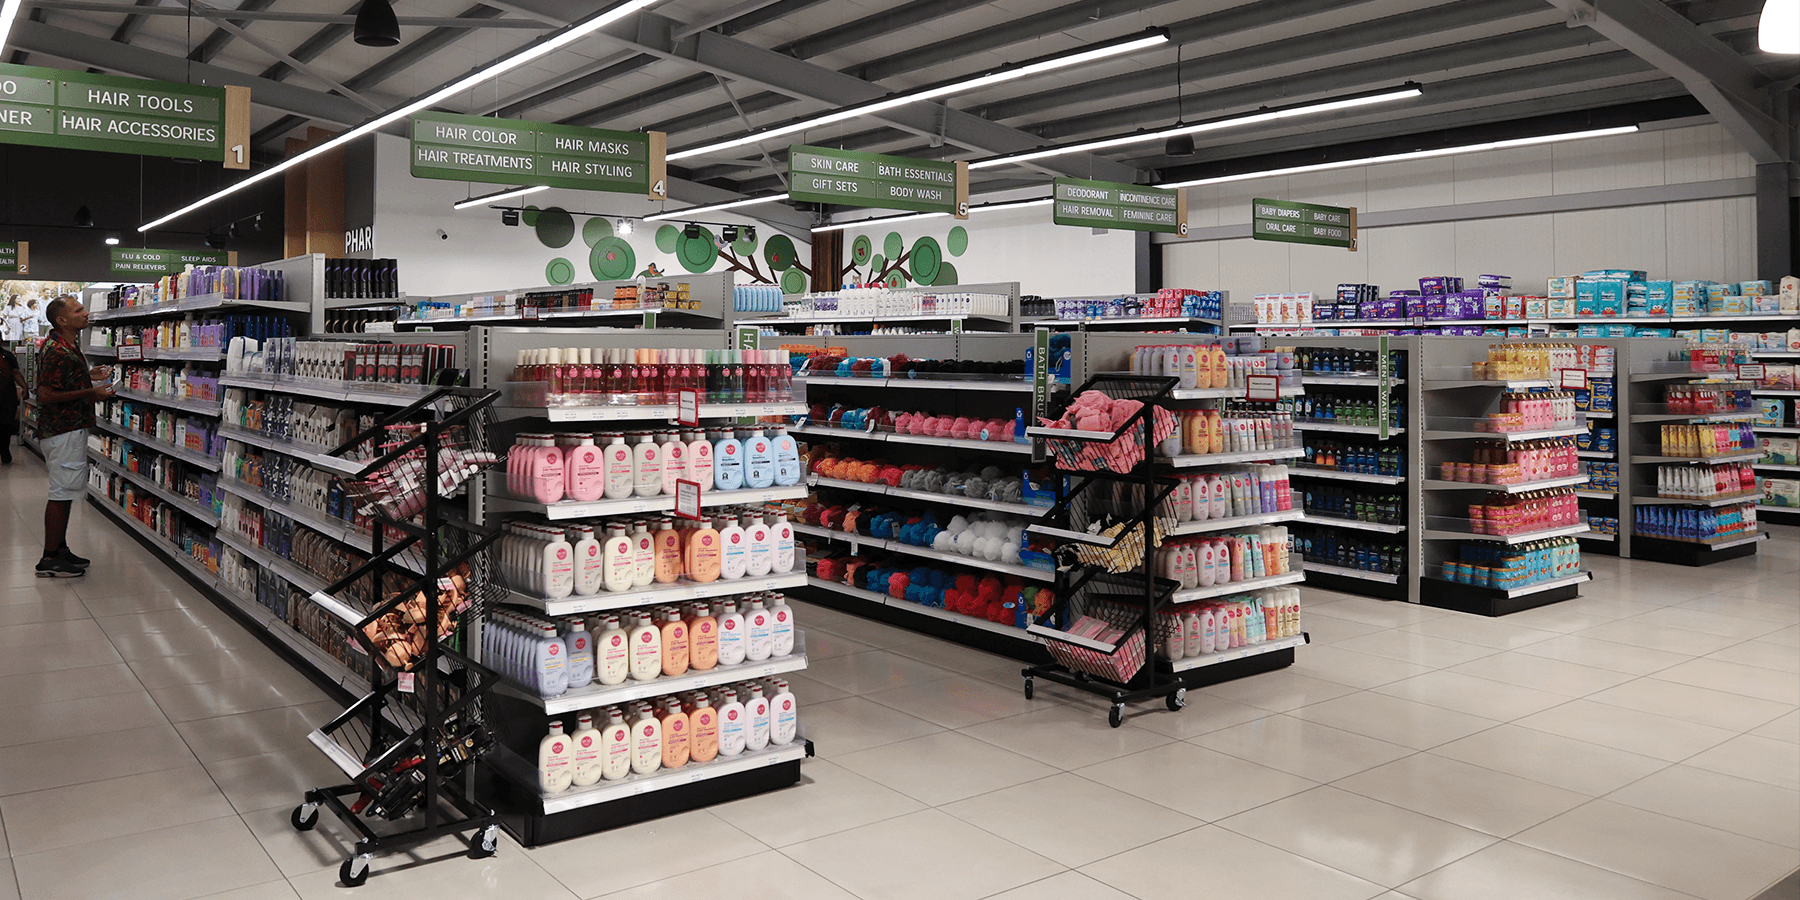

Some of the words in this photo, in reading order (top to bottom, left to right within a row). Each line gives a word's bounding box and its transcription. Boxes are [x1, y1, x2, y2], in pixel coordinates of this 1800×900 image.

[88, 89, 130, 107] HAIR
[137, 94, 194, 114] TOOLS
[62, 115, 102, 132] HAIR
[107, 119, 216, 142] ACCESSORIES
[435, 126, 467, 141] HAIR
[472, 129, 518, 145] COLOR
[555, 137, 584, 151] HAIR
[588, 141, 630, 156] MASKS
[231, 144, 244, 164] 1
[418, 149, 449, 163] HAIR
[452, 151, 533, 170] TREATMENTS
[551, 160, 581, 174] HAIR
[585, 163, 633, 178] STYLING
[811, 157, 833, 170] SKIN
[835, 160, 860, 173] CARE
[878, 165, 902, 177] BATH
[904, 167, 953, 183] ESSENTIALS
[652, 180, 666, 196] 4
[812, 178, 833, 190] GIFT
[835, 181, 858, 193] SETS
[890, 186, 914, 198] BODY
[916, 189, 942, 200] WASH
[1067, 187, 1110, 200] DEODORANT
[1120, 193, 1160, 205] INCONTINENCE
[1160, 196, 1176, 207] CARE
[958, 202, 969, 217] 5
[1062, 204, 1080, 215] HAIR
[1080, 206, 1114, 218] REMOVAL
[1123, 209, 1155, 221] FEMININE
[1155, 212, 1173, 222] CARE
[1261, 206, 1277, 217] BABY
[1277, 208, 1301, 219] DIAPERS
[1313, 212, 1327, 222] BABY
[1328, 214, 1342, 223] CARE
[1179, 222, 1188, 235] 6
[1265, 222, 1281, 232] ORAL
[1281, 224, 1297, 234] CARE
[1313, 227, 1327, 237] BABY
[1327, 228, 1342, 238] FOOD
[345, 225, 375, 254] PHAR
[142, 253, 161, 261] COLD
[181, 255, 201, 263] SLEEP
[20, 264, 27, 273] 2
[132, 263, 167, 271] RELIEVERS
[1037, 346, 1046, 380] BATH
